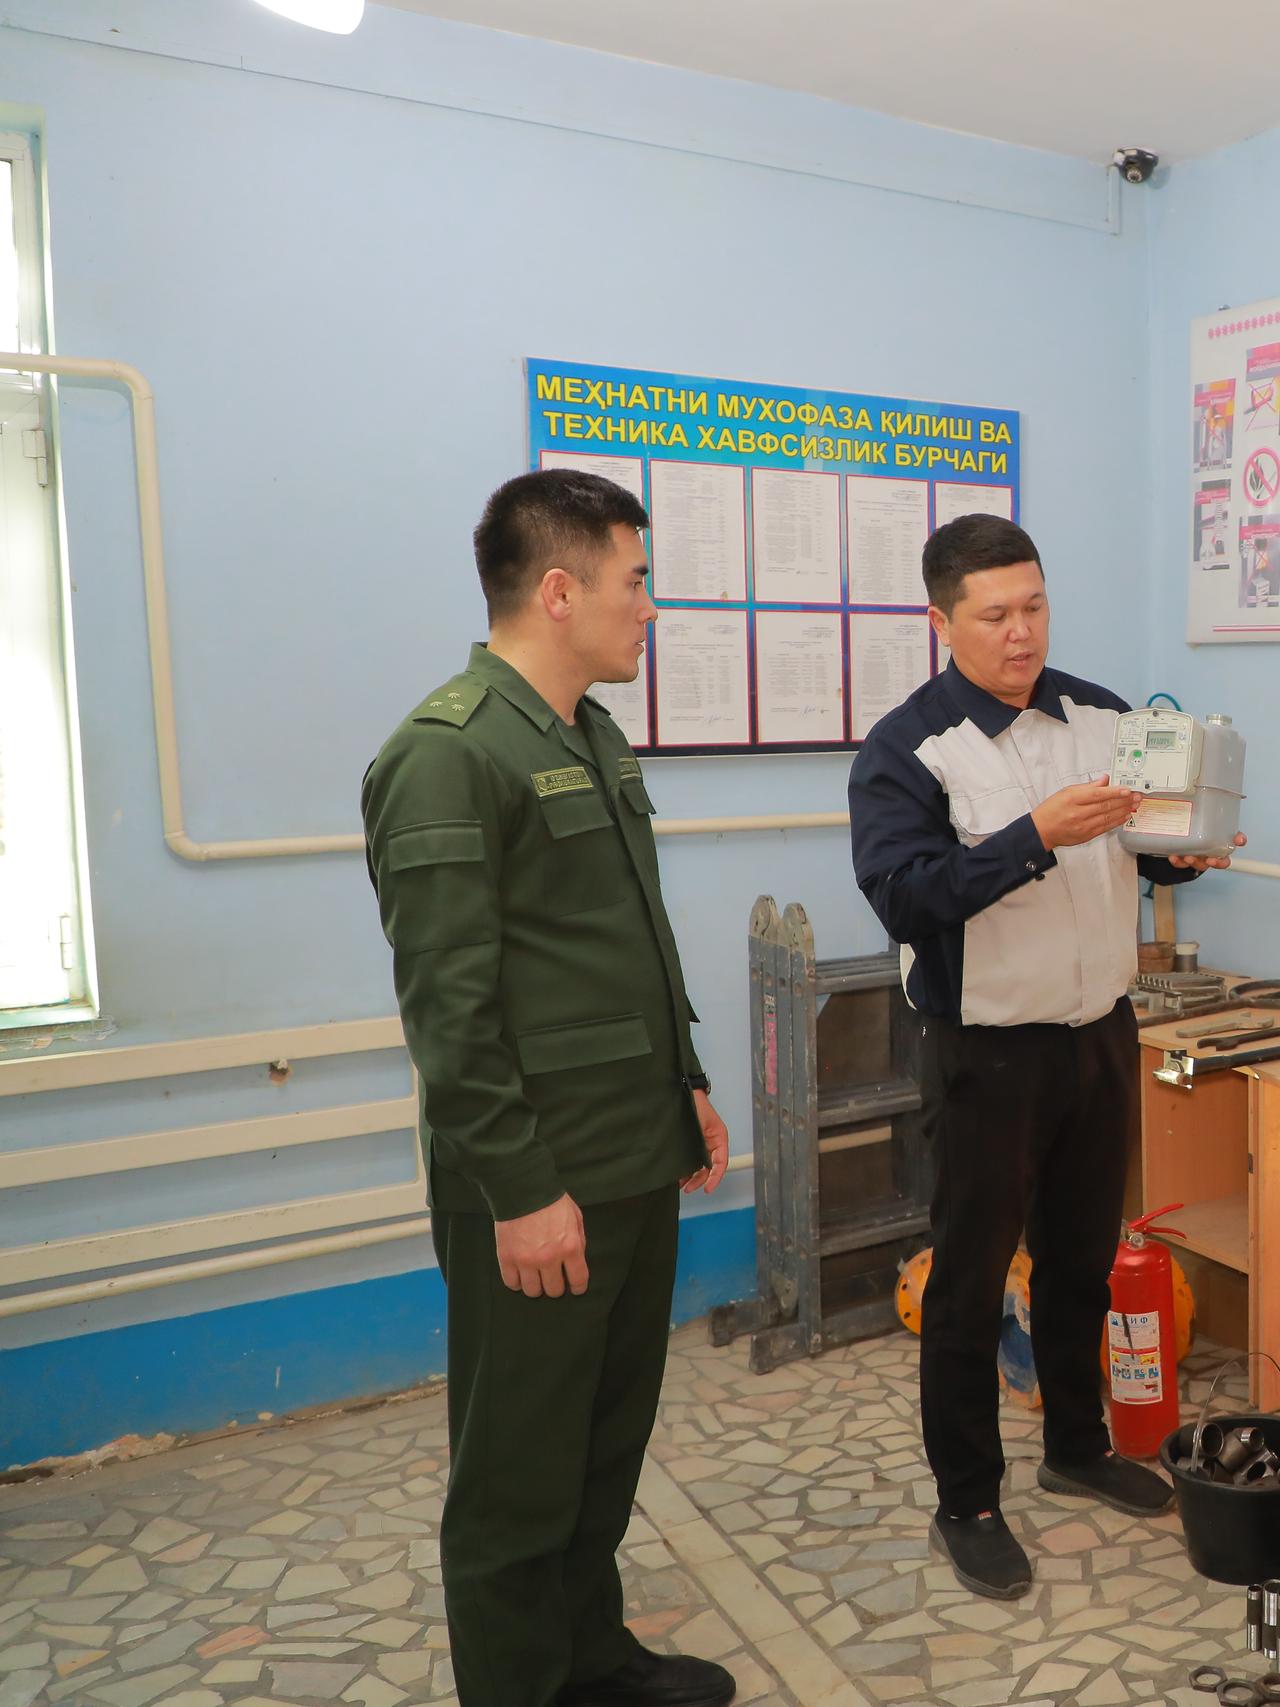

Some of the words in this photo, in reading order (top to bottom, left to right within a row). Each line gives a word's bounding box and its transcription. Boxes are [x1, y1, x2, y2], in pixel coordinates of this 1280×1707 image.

[536, 374, 708, 415] МЕҲНАТНИ
[717, 393, 873, 431] МУХОФАЗА
[880, 410, 972, 440] ҚИЛИШ
[979, 420, 1013, 444] ВА
[542, 411, 690, 448] ТЕХНИКА
[696, 425, 888, 465] ХАВФСИЗЛИК
[894, 443, 1008, 474] БУРЧАГИ
